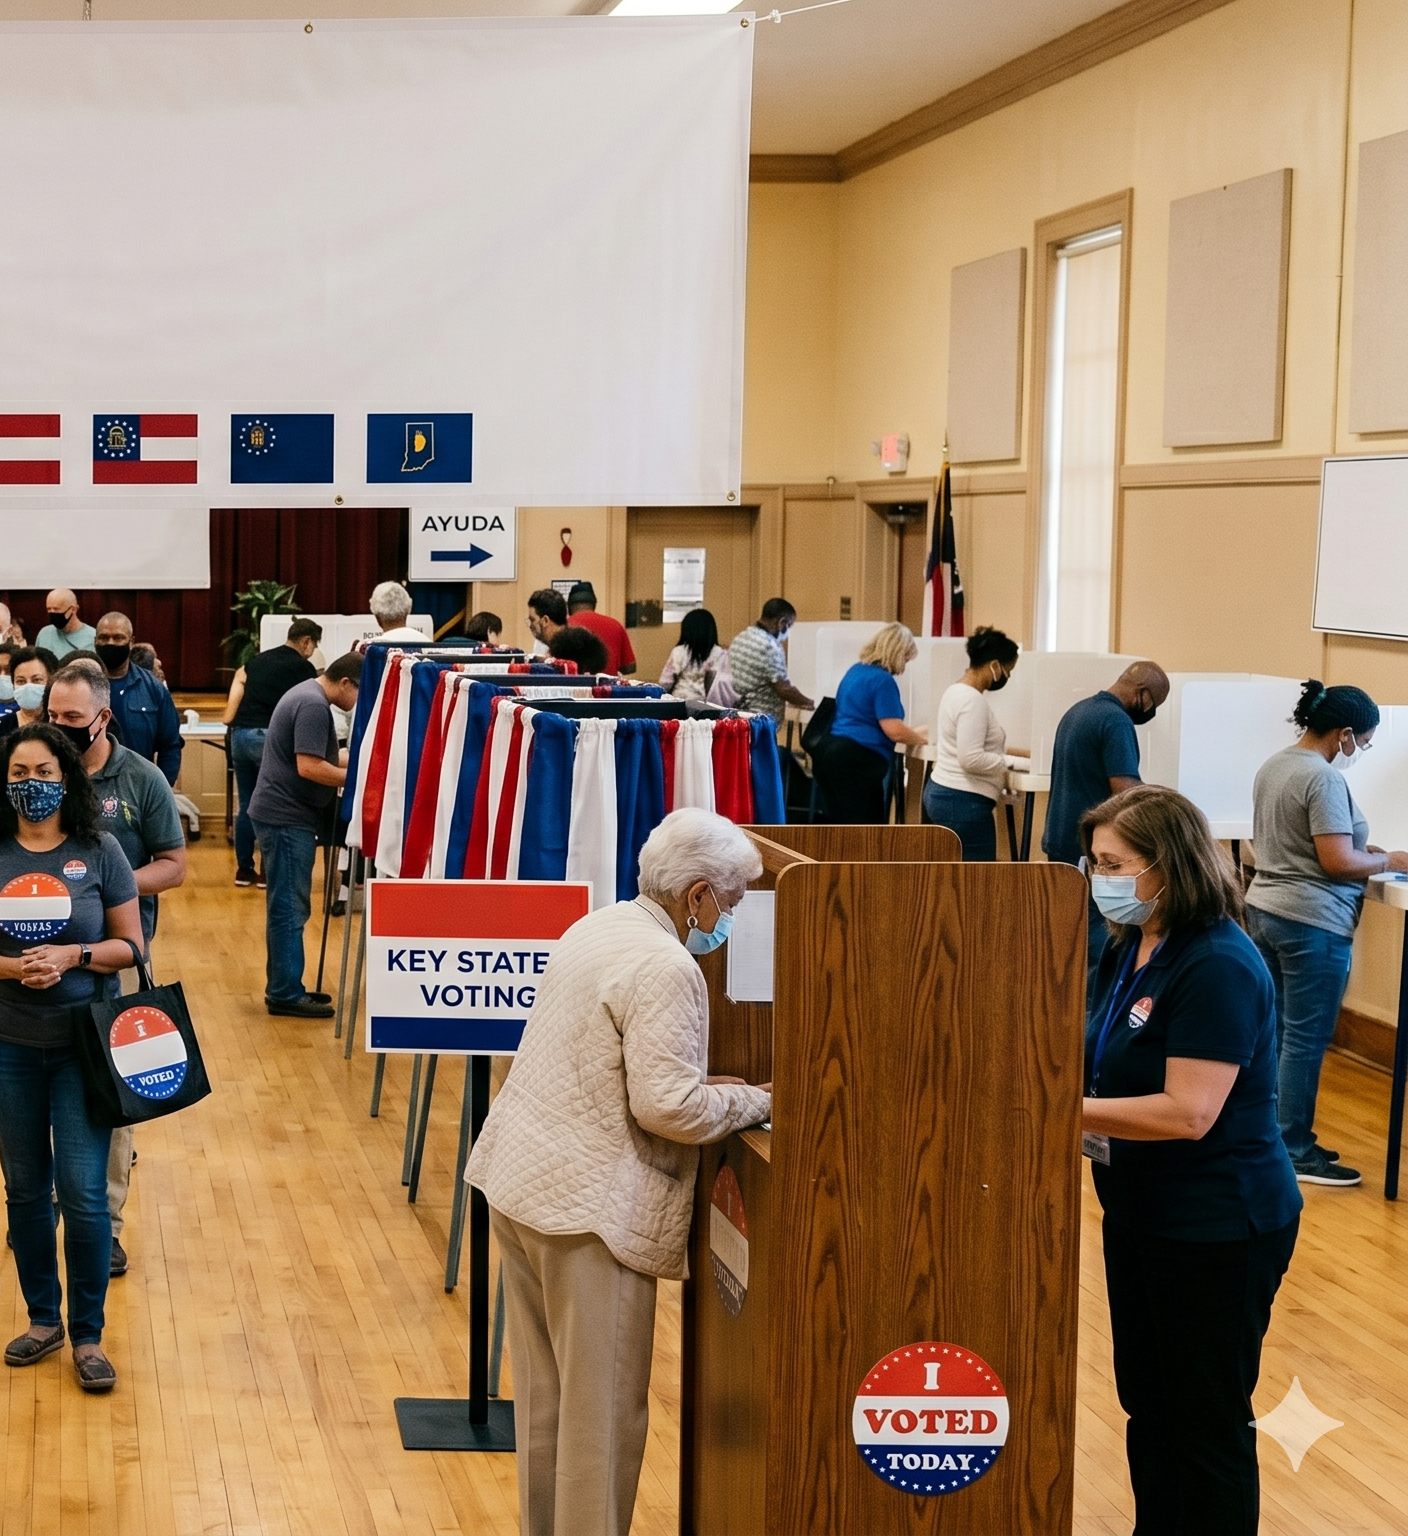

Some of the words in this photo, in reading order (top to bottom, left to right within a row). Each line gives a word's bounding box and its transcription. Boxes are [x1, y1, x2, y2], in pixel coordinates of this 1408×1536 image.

[421, 515, 505, 532] AYUDA
[387, 948, 448, 972] KEY
[419, 984, 537, 1008] VOTING
[134, 1019, 147, 1037] I
[138, 1069, 174, 1086] VOTED
[923, 1362, 941, 1390] I
[862, 1409, 998, 1435] VOTED
[886, 1453, 975, 1471] TODAY
